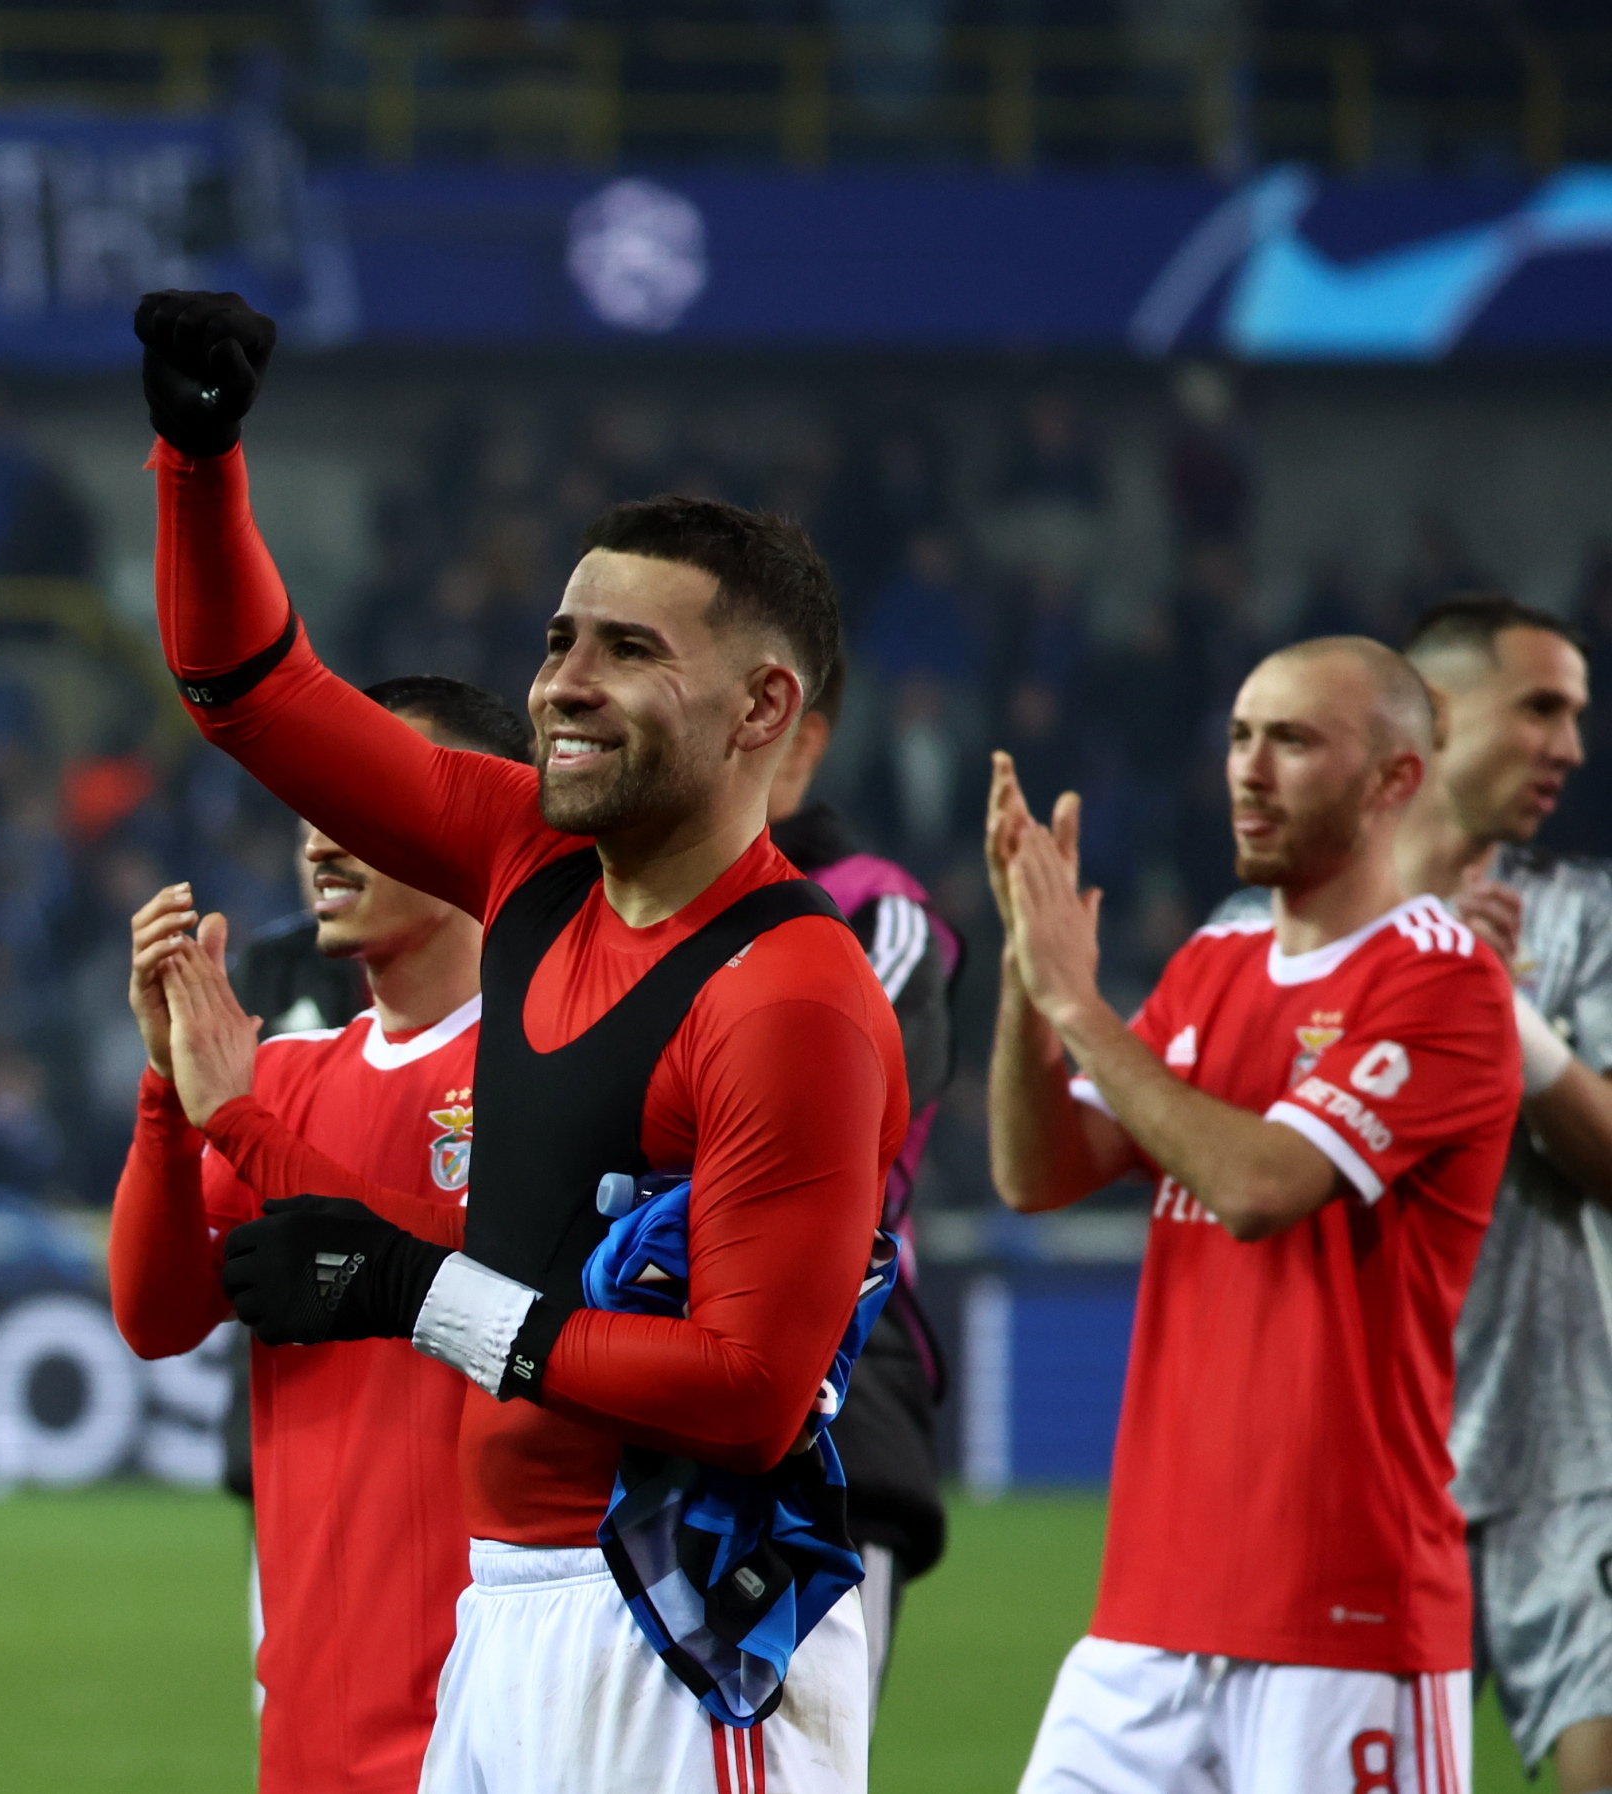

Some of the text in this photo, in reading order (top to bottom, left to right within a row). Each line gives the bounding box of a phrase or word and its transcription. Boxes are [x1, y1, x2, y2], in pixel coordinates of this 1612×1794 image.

[1292, 1076, 1393, 1153] BETANO
[325, 1252, 365, 1312] adidas
[512, 1353, 535, 1381] 30
